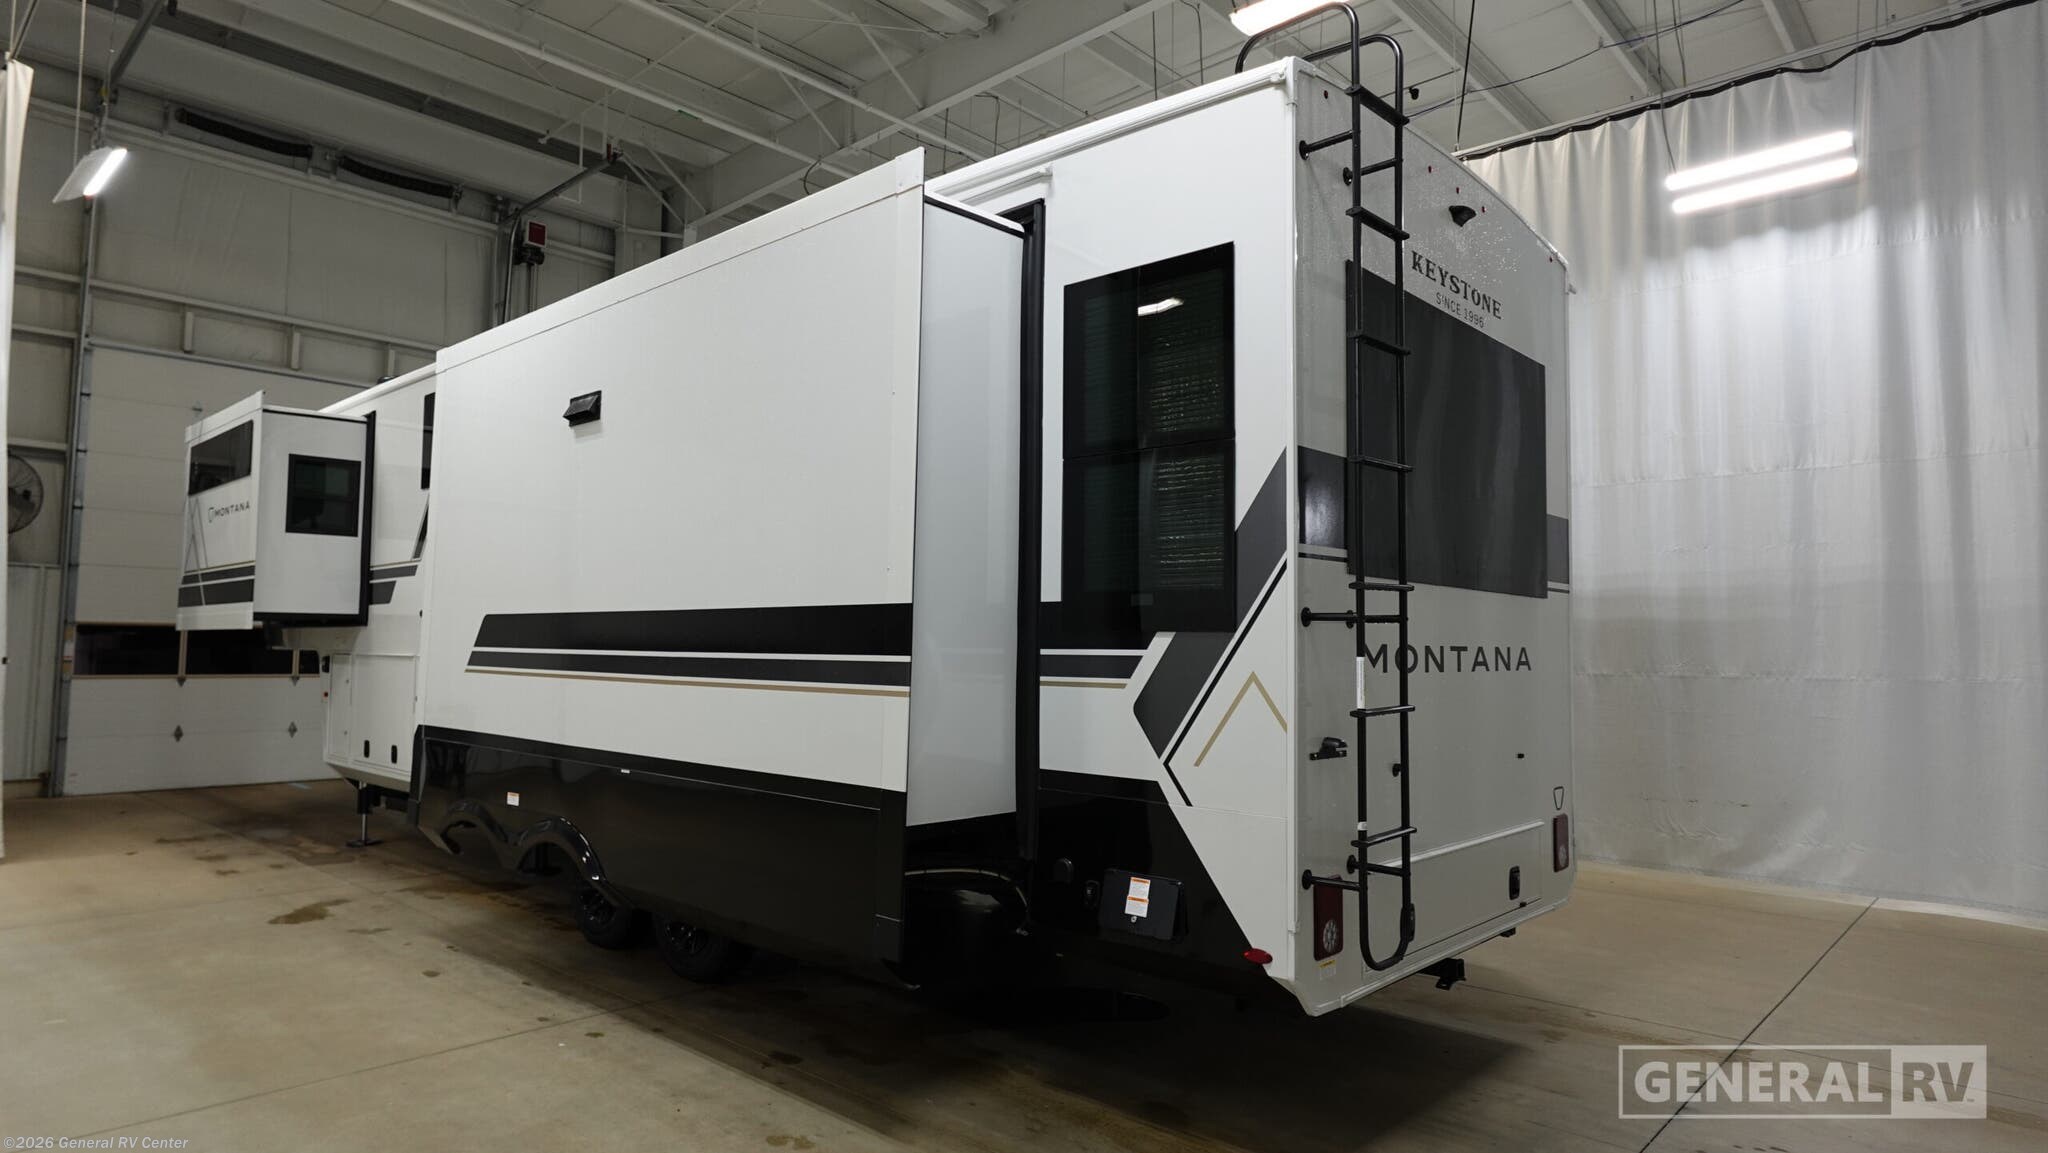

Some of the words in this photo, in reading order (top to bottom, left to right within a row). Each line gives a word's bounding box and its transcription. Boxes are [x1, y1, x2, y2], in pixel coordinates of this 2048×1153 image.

[1411, 250, 1502, 320] KEYSTONE
[1435, 292, 1461, 315] SINCE
[1463, 308, 1485, 329] 1996
[1364, 643, 1532, 674] MONTANA
